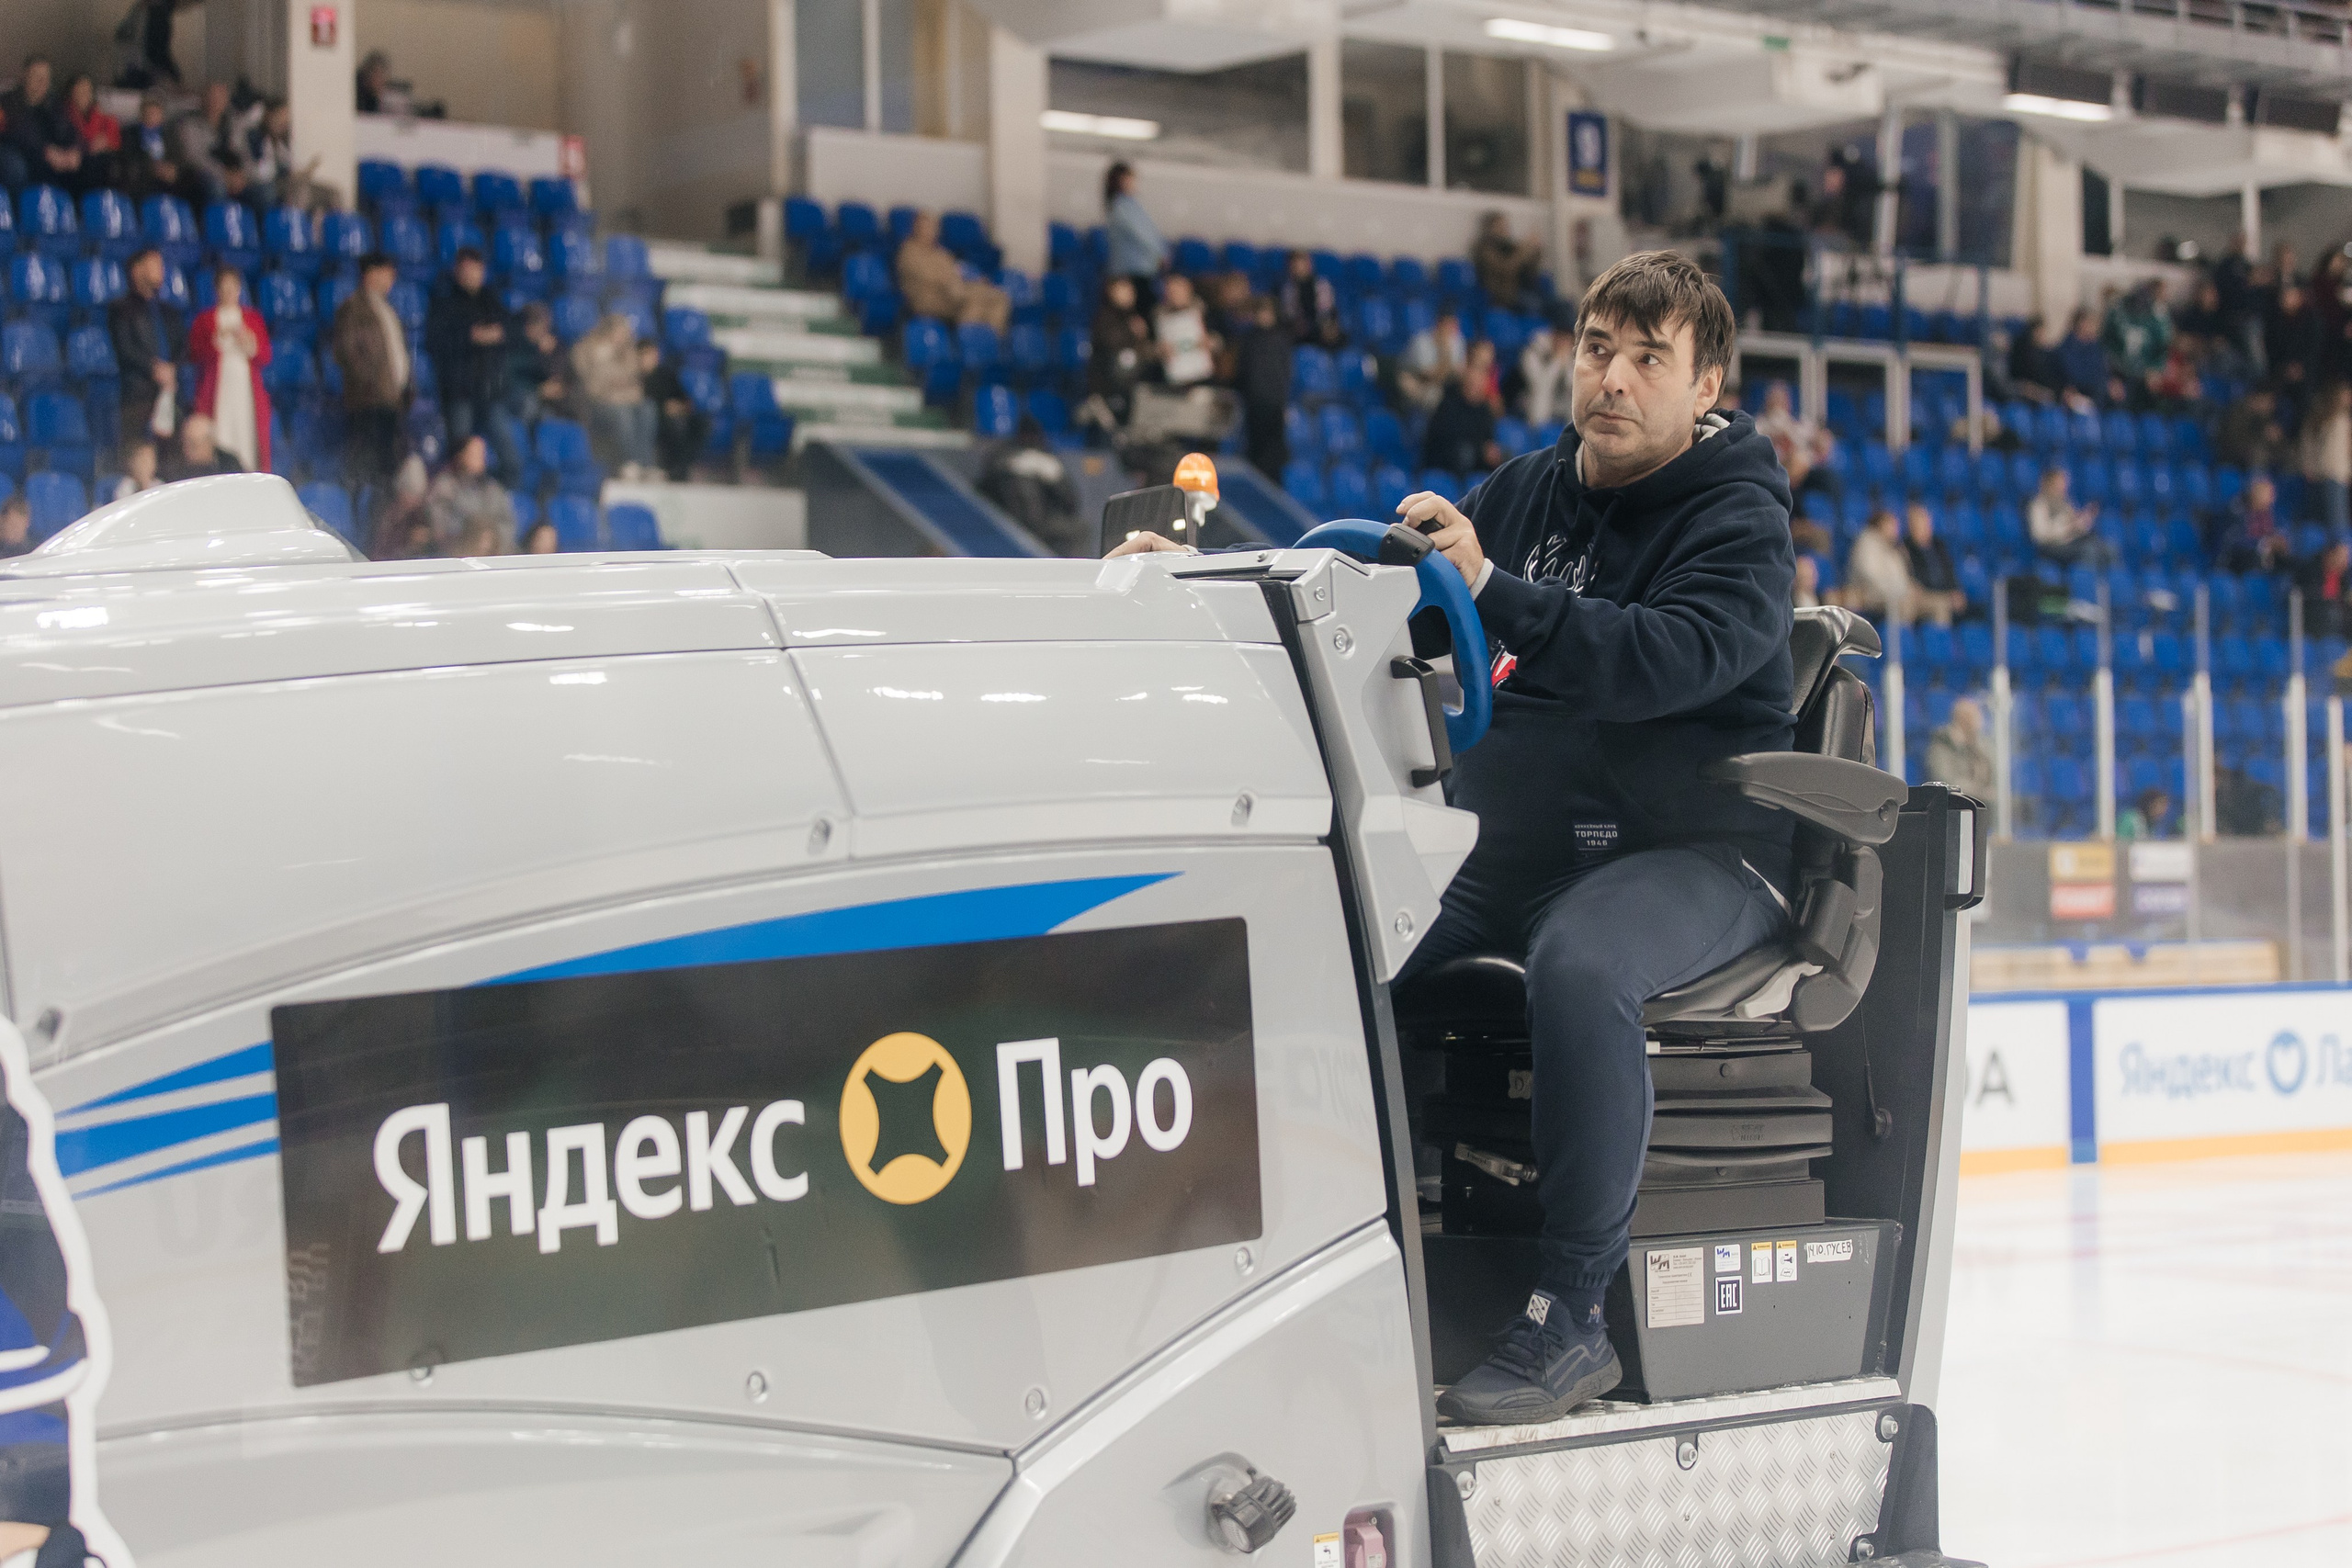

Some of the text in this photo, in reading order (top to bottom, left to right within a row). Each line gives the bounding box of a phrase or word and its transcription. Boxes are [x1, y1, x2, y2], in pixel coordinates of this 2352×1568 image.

[1575, 830, 1618, 839] ТОРПЕДО
[2119, 1041, 2256, 1100] Яндекс
[374, 1037, 1193, 1254] Яндекс Про
[1720, 1283, 1737, 1308] EAC
